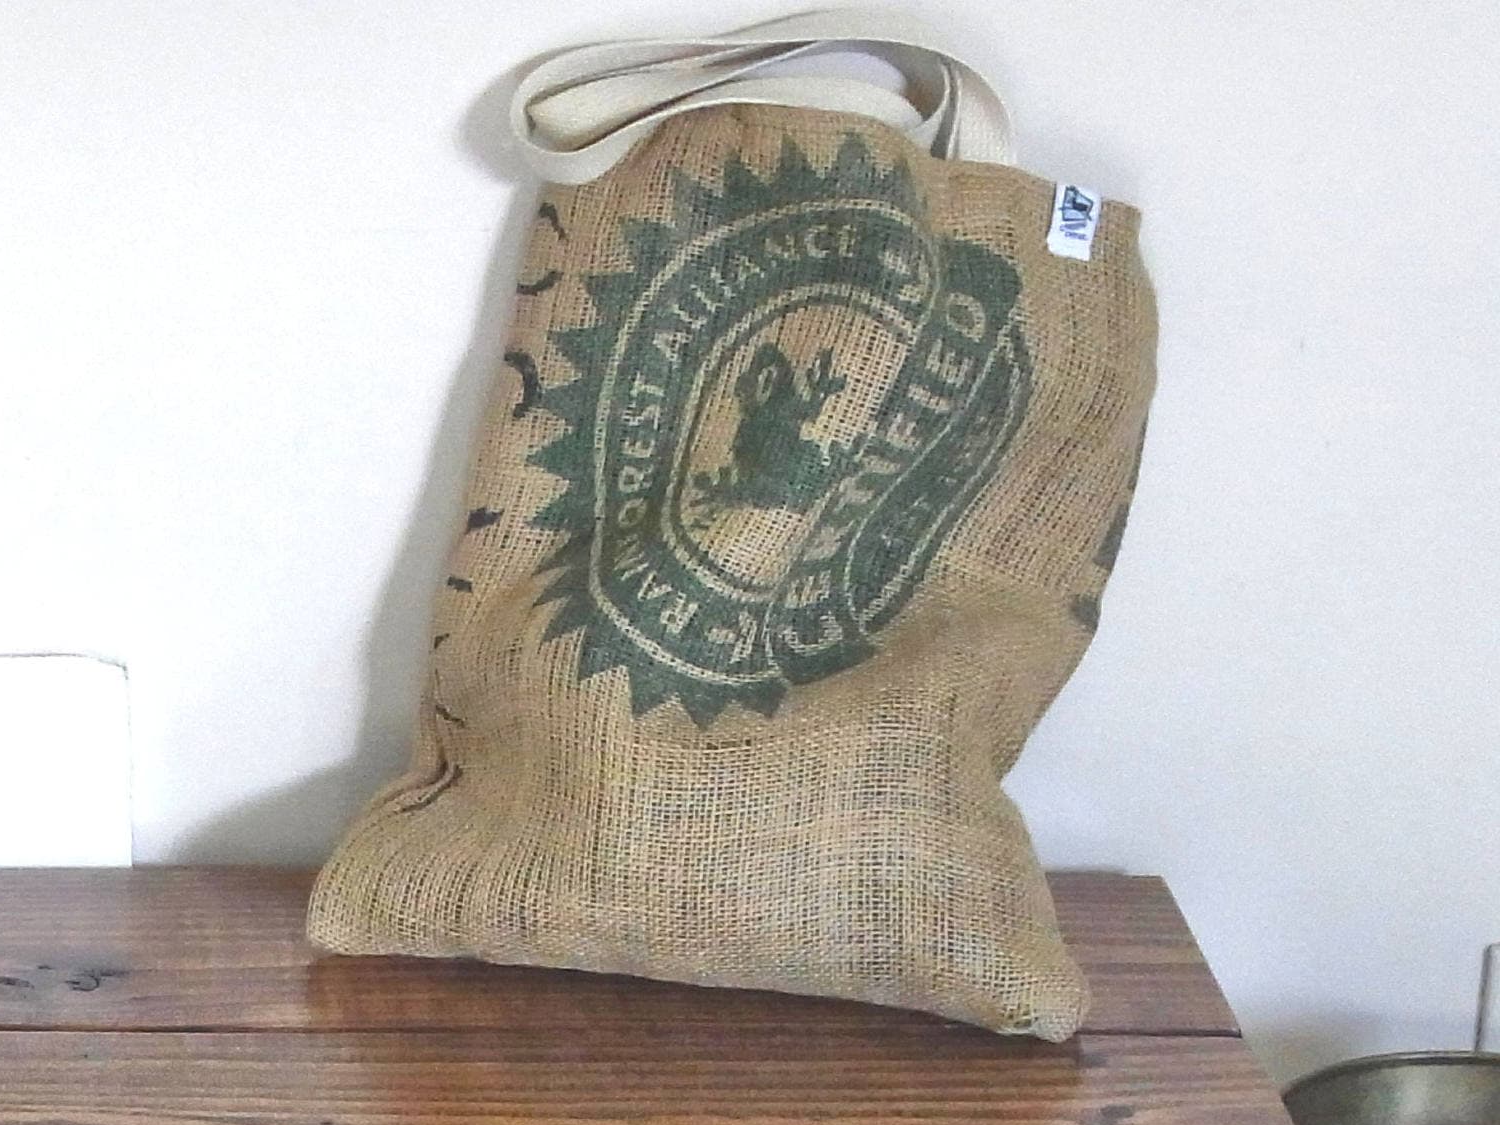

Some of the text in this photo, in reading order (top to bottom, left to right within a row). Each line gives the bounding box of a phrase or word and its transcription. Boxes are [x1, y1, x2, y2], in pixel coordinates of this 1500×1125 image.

[614, 224, 857, 631] RAINOREST ALLIANCE
[781, 292, 985, 653] CERTIFIED
